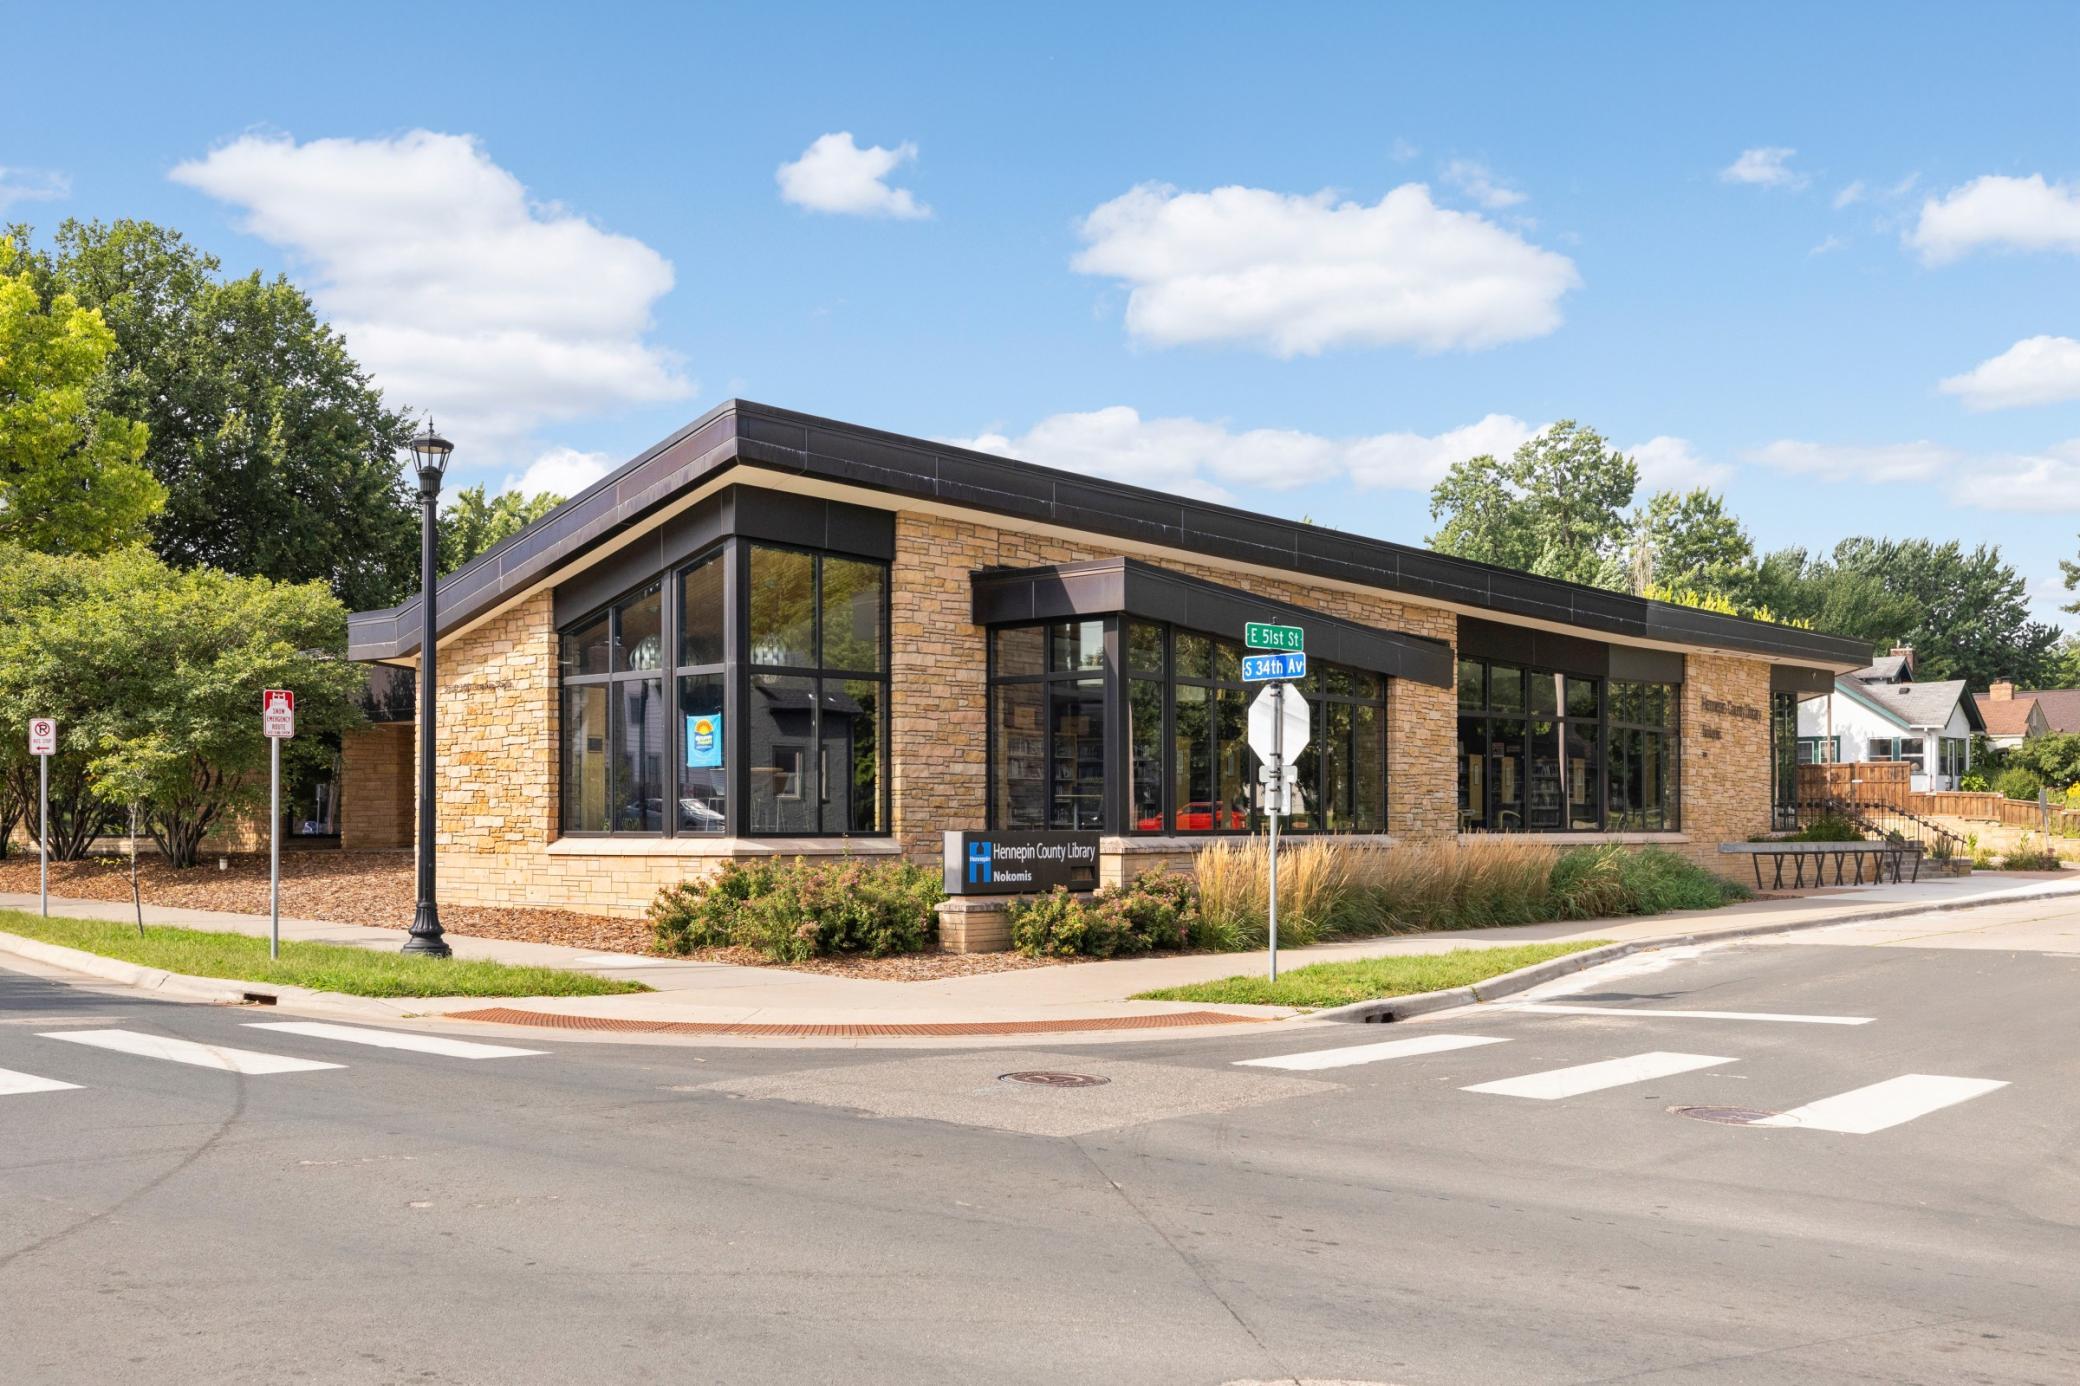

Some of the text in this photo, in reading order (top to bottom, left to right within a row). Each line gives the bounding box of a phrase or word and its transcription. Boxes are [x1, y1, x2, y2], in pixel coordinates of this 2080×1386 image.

[1251, 628, 1299, 647] E 51st St
[1245, 658, 1303, 677] S 34th Av
[993, 841, 1096, 864] Hennepin County Library
[993, 870, 1032, 882] Nokomis
